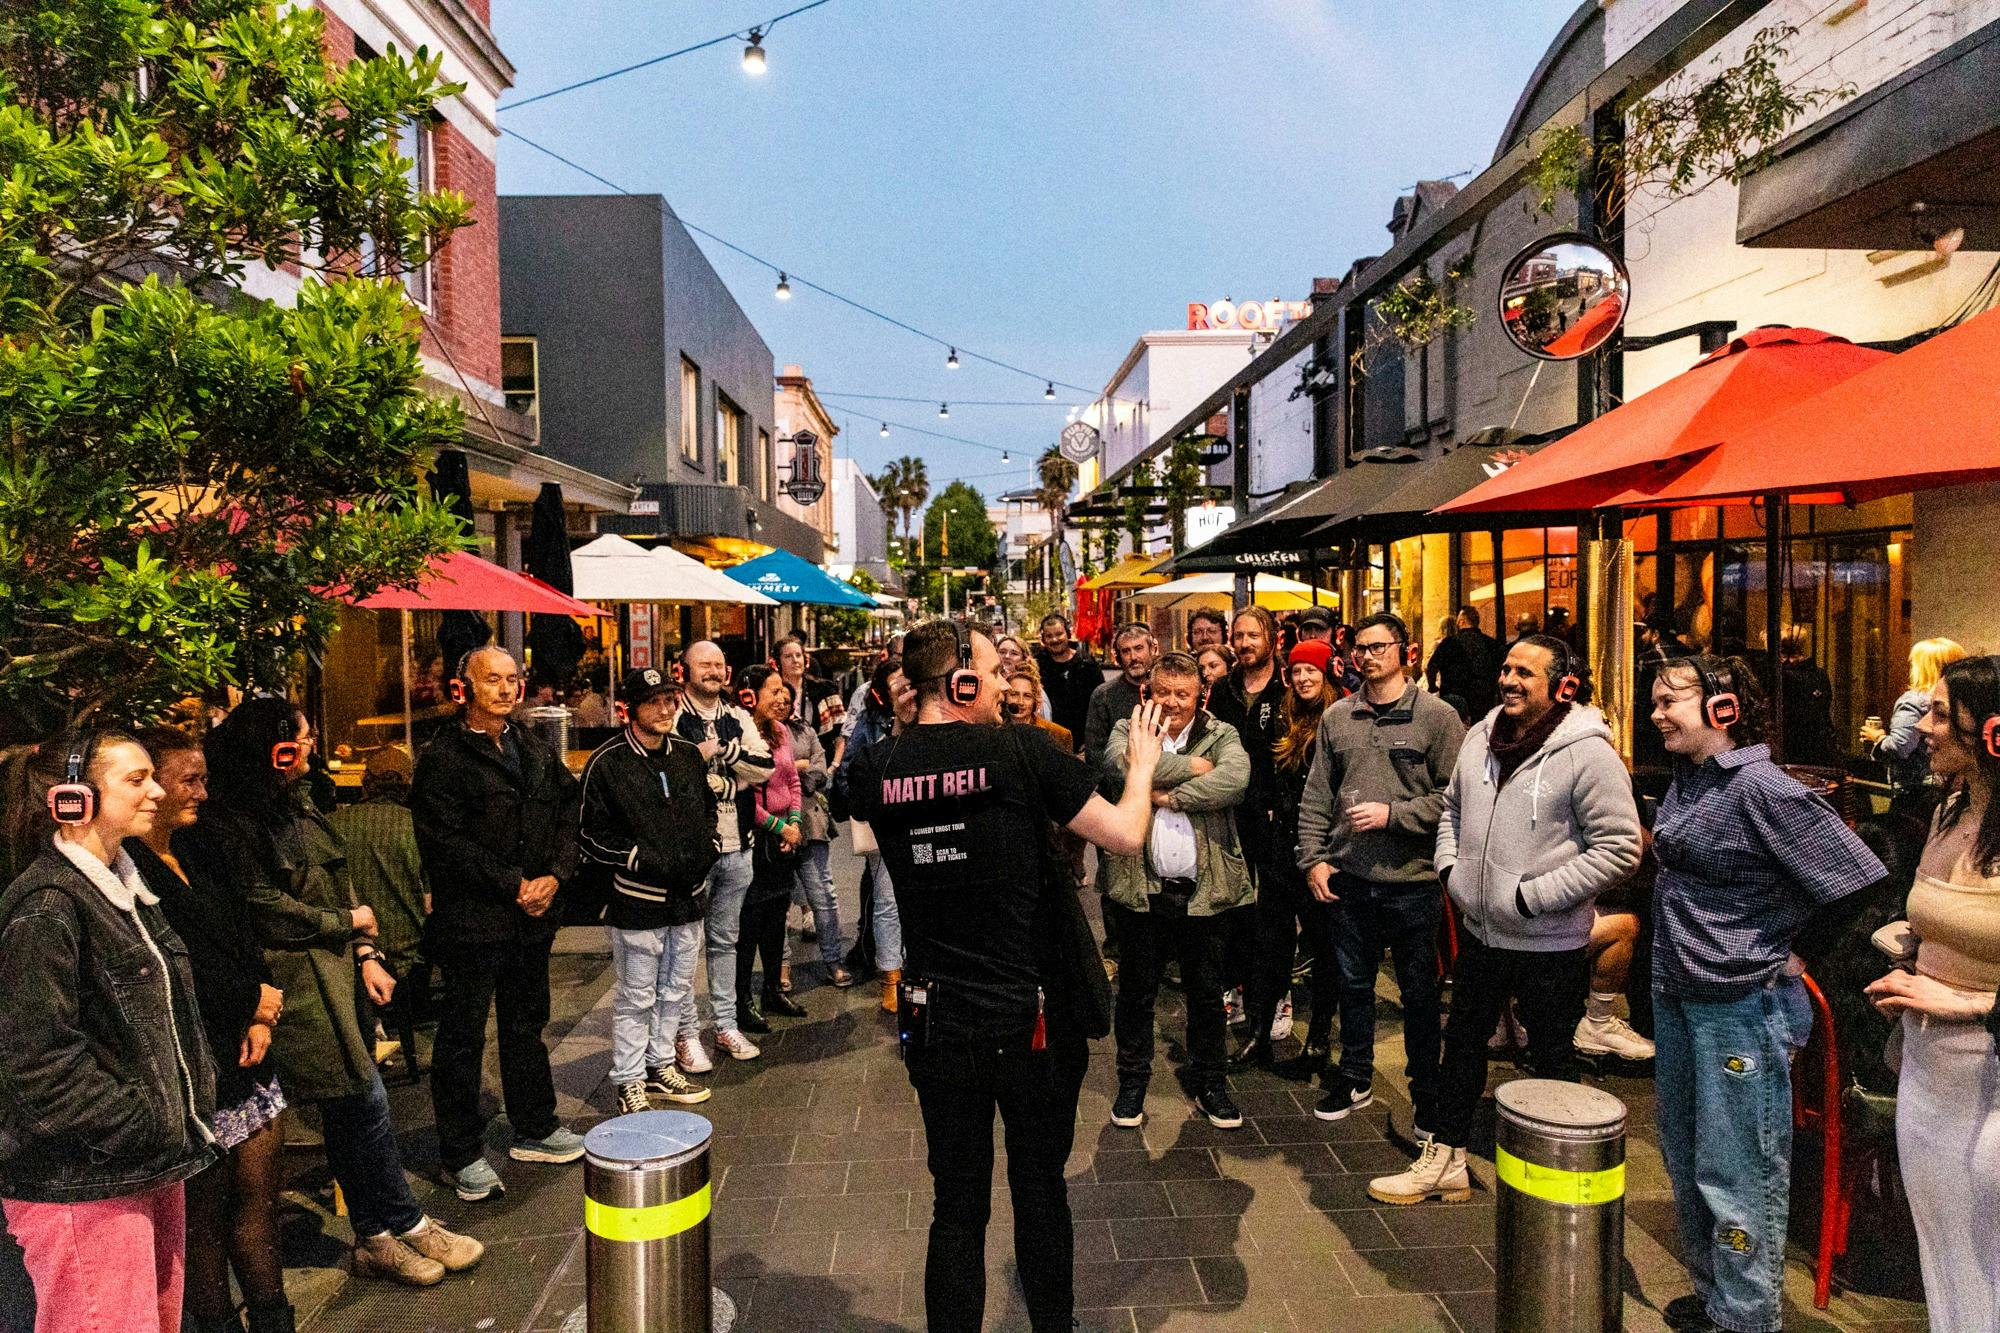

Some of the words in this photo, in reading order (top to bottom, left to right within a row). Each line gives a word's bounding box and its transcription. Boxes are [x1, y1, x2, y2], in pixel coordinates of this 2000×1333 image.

[1212, 444, 1229, 455] BAR
[1199, 512, 1223, 528] HOT
[1235, 550, 1300, 563] CHICKEN
[883, 774, 937, 805] MATT
[943, 767, 992, 797] BELL
[914, 826, 934, 835] COMEDY
[948, 852, 967, 861] TICKETS
